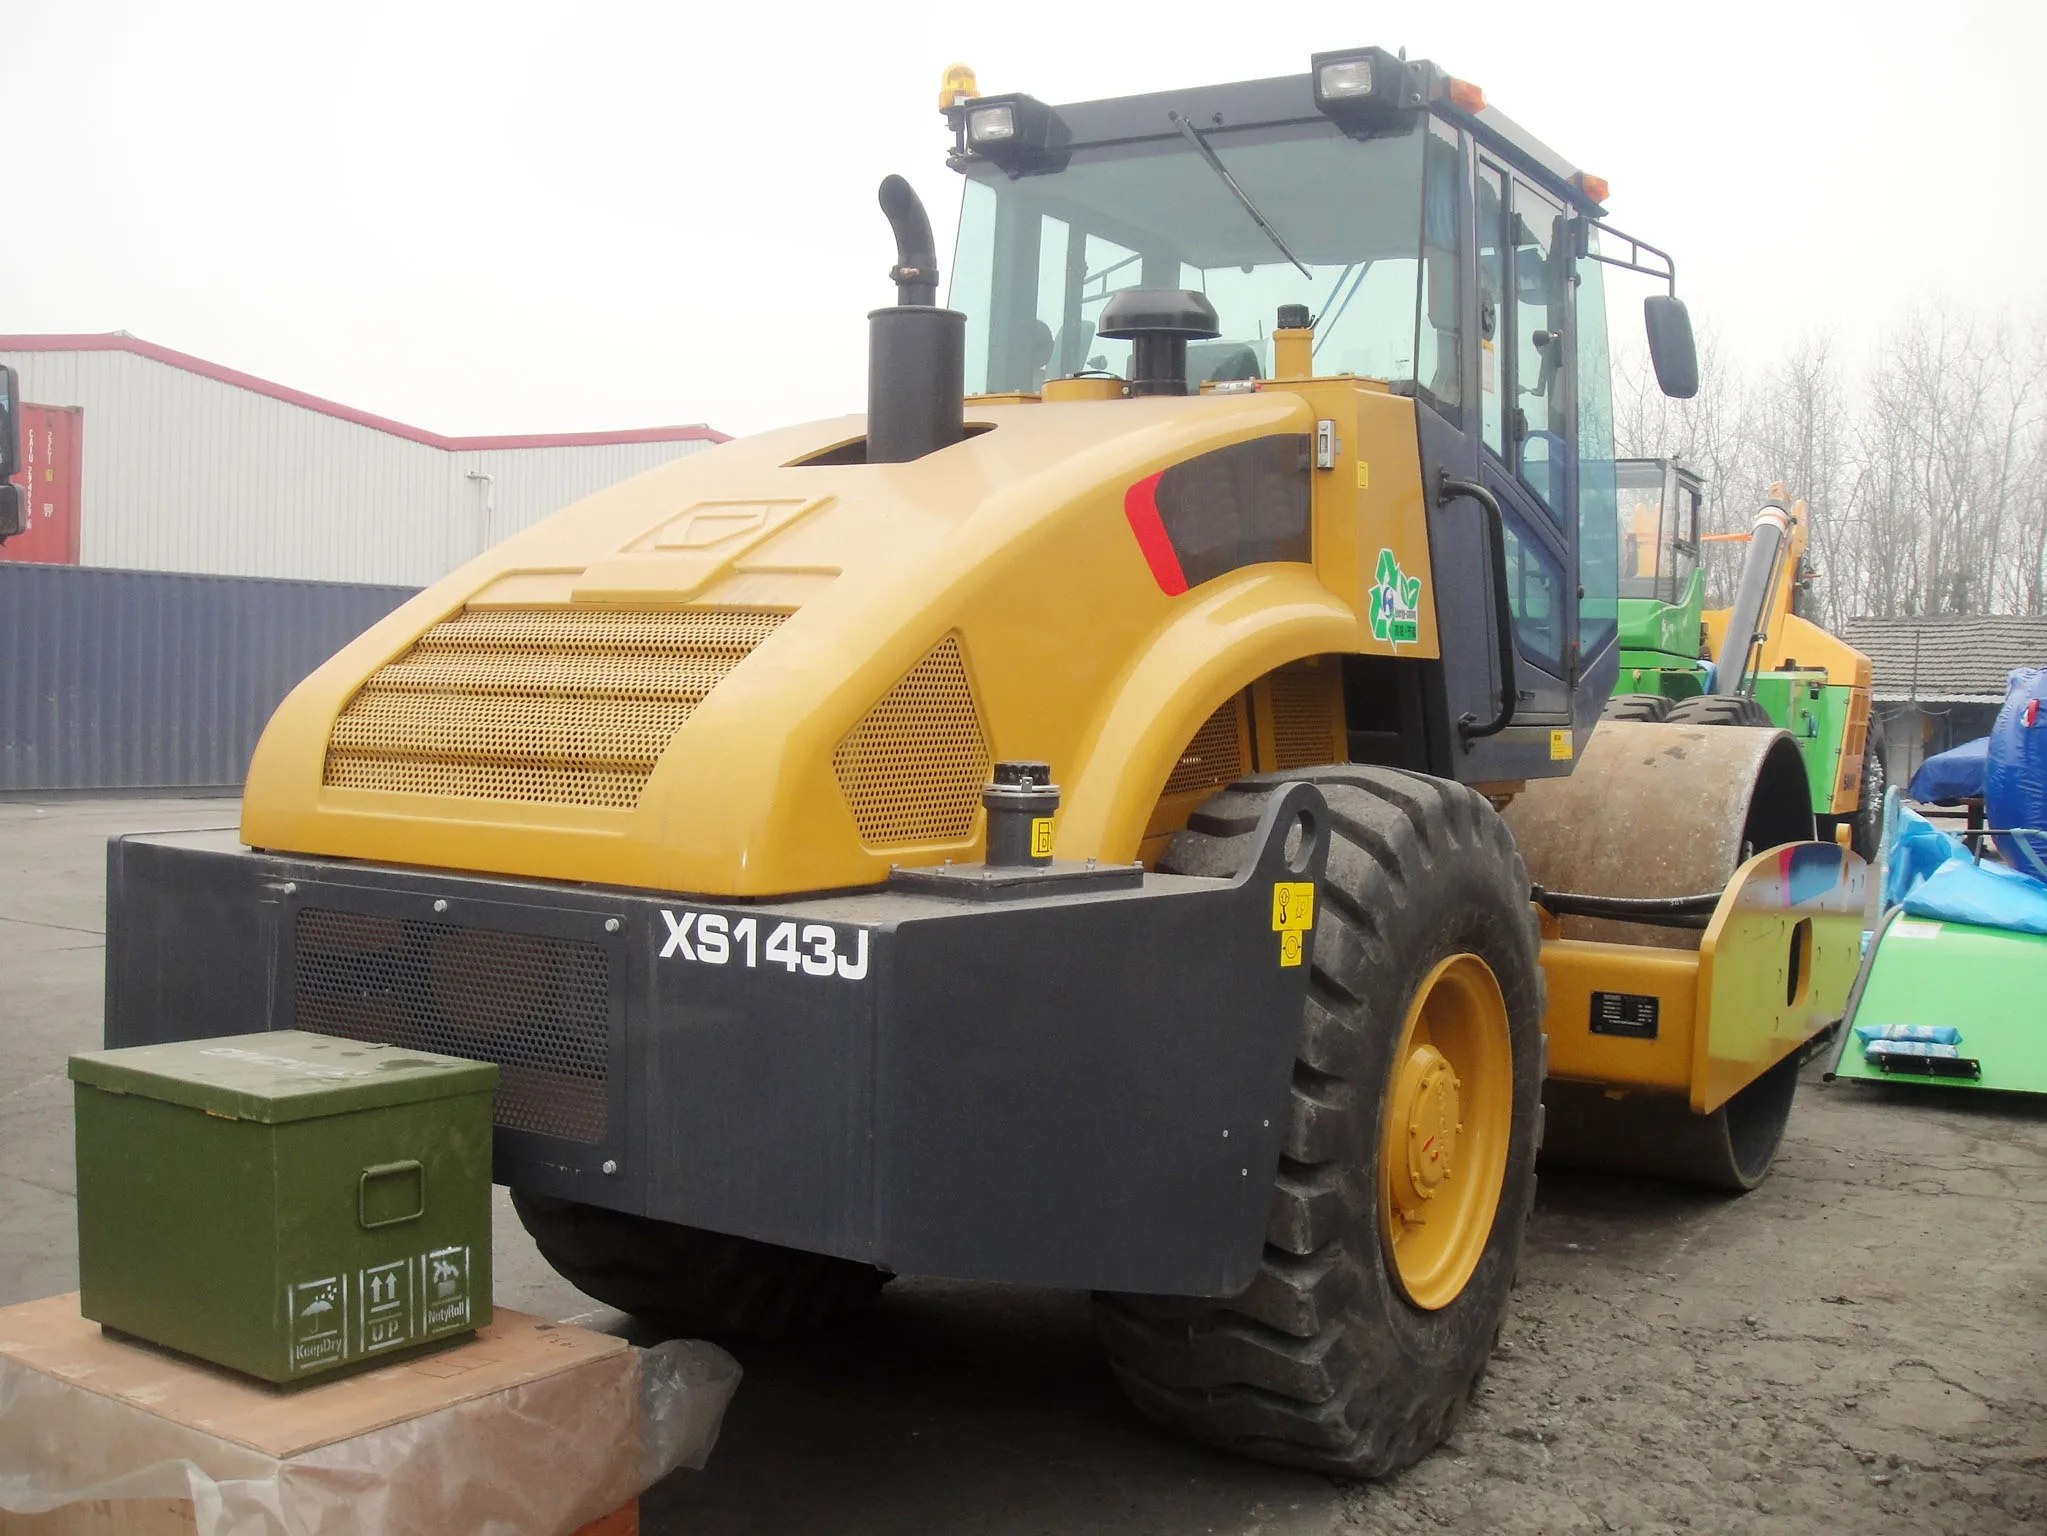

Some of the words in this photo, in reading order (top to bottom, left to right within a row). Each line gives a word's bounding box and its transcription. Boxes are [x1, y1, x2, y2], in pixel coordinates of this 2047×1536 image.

[659, 909, 869, 980] XS143J
[372, 1320, 399, 1342] UP
[296, 1338, 343, 1360] KeepDry
